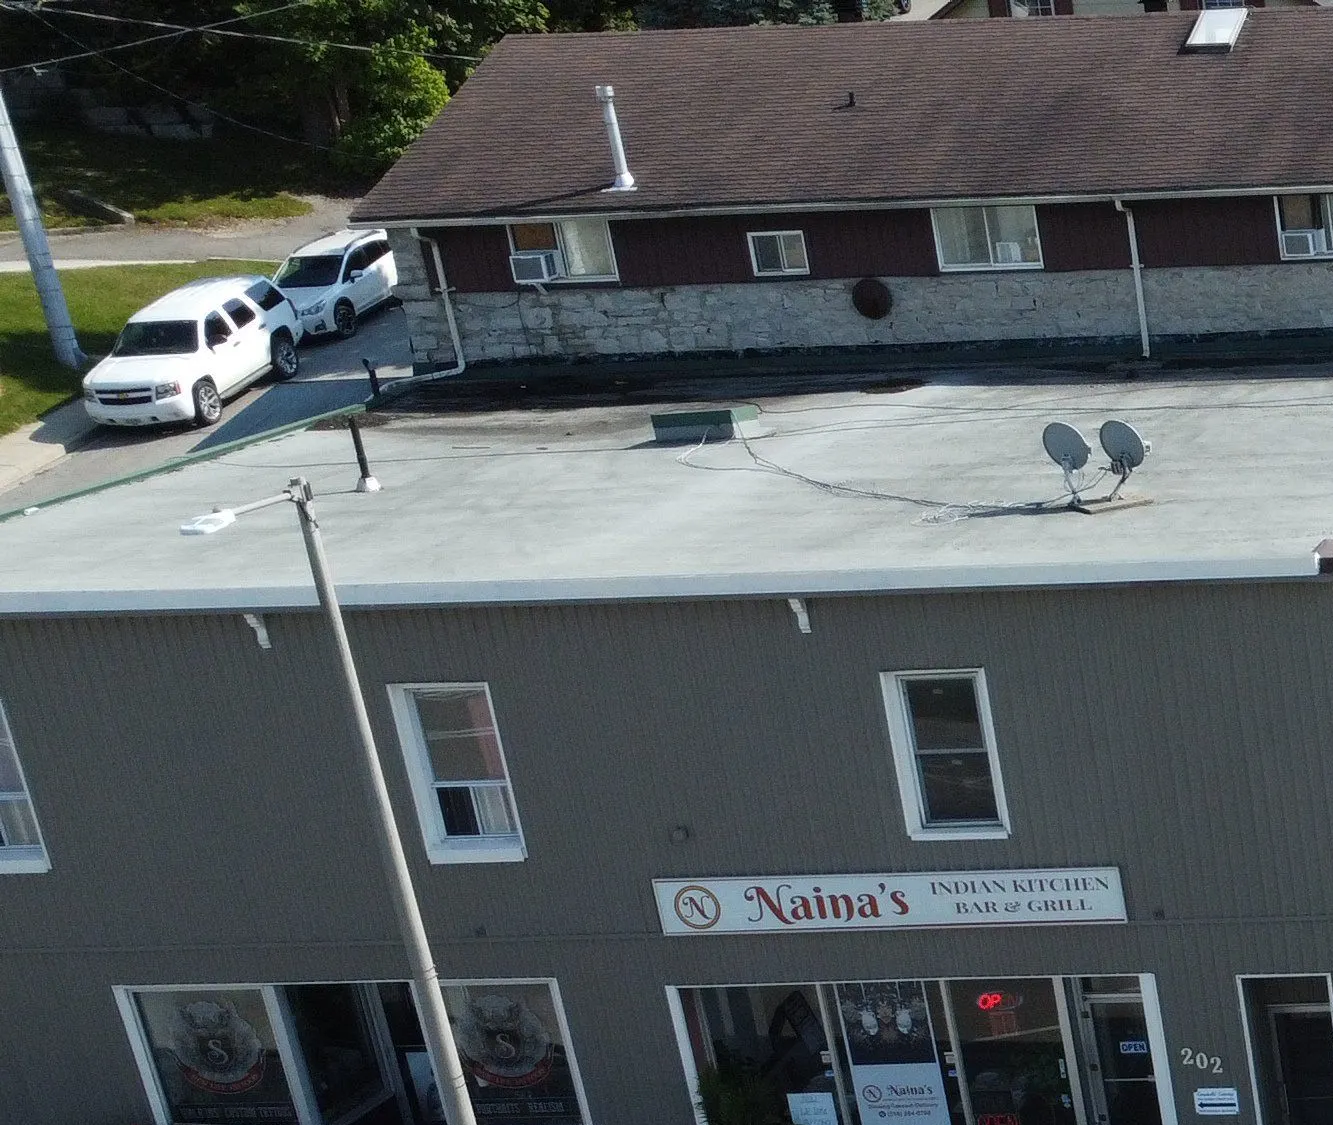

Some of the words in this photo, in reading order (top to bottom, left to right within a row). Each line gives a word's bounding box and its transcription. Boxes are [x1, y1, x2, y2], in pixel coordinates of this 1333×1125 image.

[929, 879, 1007, 896] INDIAN
[1012, 876, 1110, 894] KITCHEN
[744, 883, 910, 925] Naina's
[955, 901, 999, 914] BAR
[1004, 901, 1021, 913] &
[1028, 898, 1093, 913] GRILL
[1121, 1041, 1147, 1052] OPEN
[1180, 1047, 1224, 1074] 202
[887, 1084, 933, 1097] Naina's
